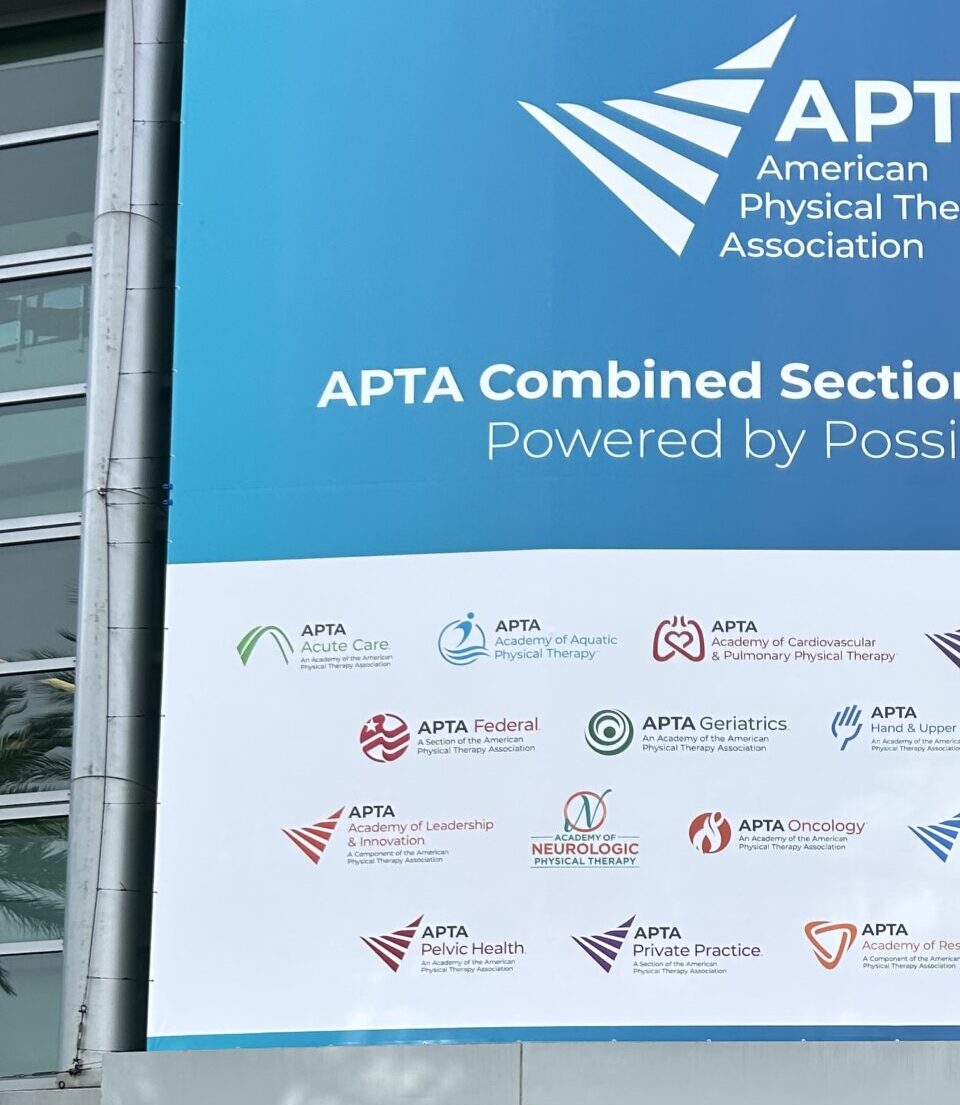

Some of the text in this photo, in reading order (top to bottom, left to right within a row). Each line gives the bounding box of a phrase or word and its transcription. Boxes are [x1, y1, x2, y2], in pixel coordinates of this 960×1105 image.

[756, 154, 928, 181] American
[741, 192, 882, 225] Physical
[719, 231, 923, 258] Association
[317, 366, 464, 408] APTA
[480, 360, 761, 401] Combined
[489, 418, 721, 460] Powered
[745, 418, 806, 468] by
[301, 623, 346, 636] APTA
[495, 619, 541, 632] APTA
[712, 620, 758, 632] APTA
[301, 639, 389, 653] Acute Care
[495, 634, 618, 648] Academy of Aquatic
[711, 636, 876, 651] Academy of Cardiovascular
[494, 648, 596, 662] Physical Therapy
[711, 650, 896, 663] & Pulmonary Physical Therapy
[871, 706, 917, 718] APTA
[417, 717, 538, 734] APTA Federal
[642, 716, 787, 730] APTA Geriatrics
[871, 723, 904, 733] Hand
[907, 723, 916, 733] &
[919, 723, 957, 735] Upper
[348, 805, 396, 818] APTA
[348, 819, 494, 834] Academy of Leadership
[738, 819, 865, 835] APTA Oncology
[347, 836, 425, 847] & Innovation
[532, 843, 639, 855] NEUROLOGIC
[534, 857, 637, 865] PHYSICAL THERAPY
[422, 926, 469, 939] APTA
[634, 927, 682, 939] APTA
[861, 924, 908, 936] APTA
[422, 941, 524, 956] Pelvic Health
[633, 943, 761, 956] Private Practice
[862, 940, 920, 952] Academy
[923, 940, 936, 950] of
